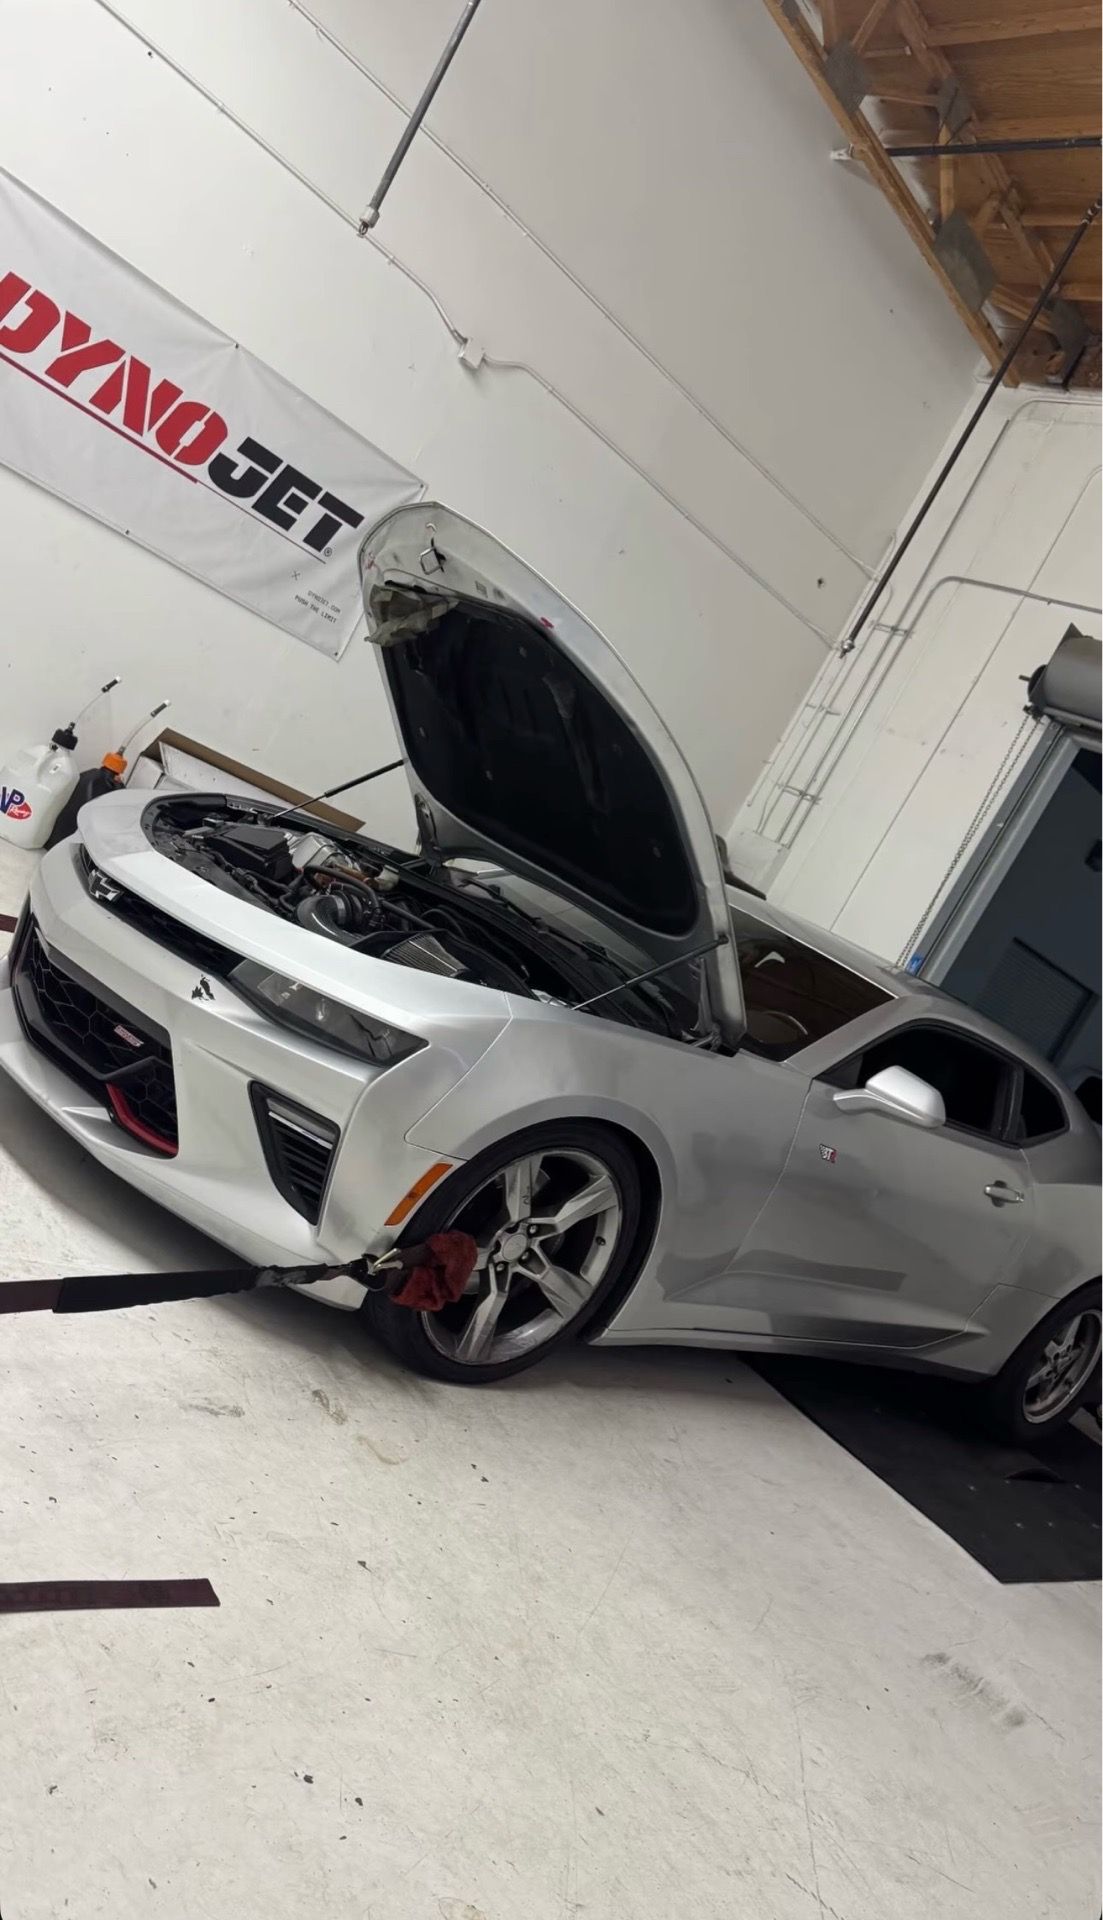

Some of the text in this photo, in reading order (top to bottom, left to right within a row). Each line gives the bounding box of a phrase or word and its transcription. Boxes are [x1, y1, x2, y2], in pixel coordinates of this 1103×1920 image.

[0, 271, 365, 553] DYNOJET
[310, 604, 320, 614] THE
[321, 611, 337, 623] LIMIT
[0, 786, 25, 814] VP
